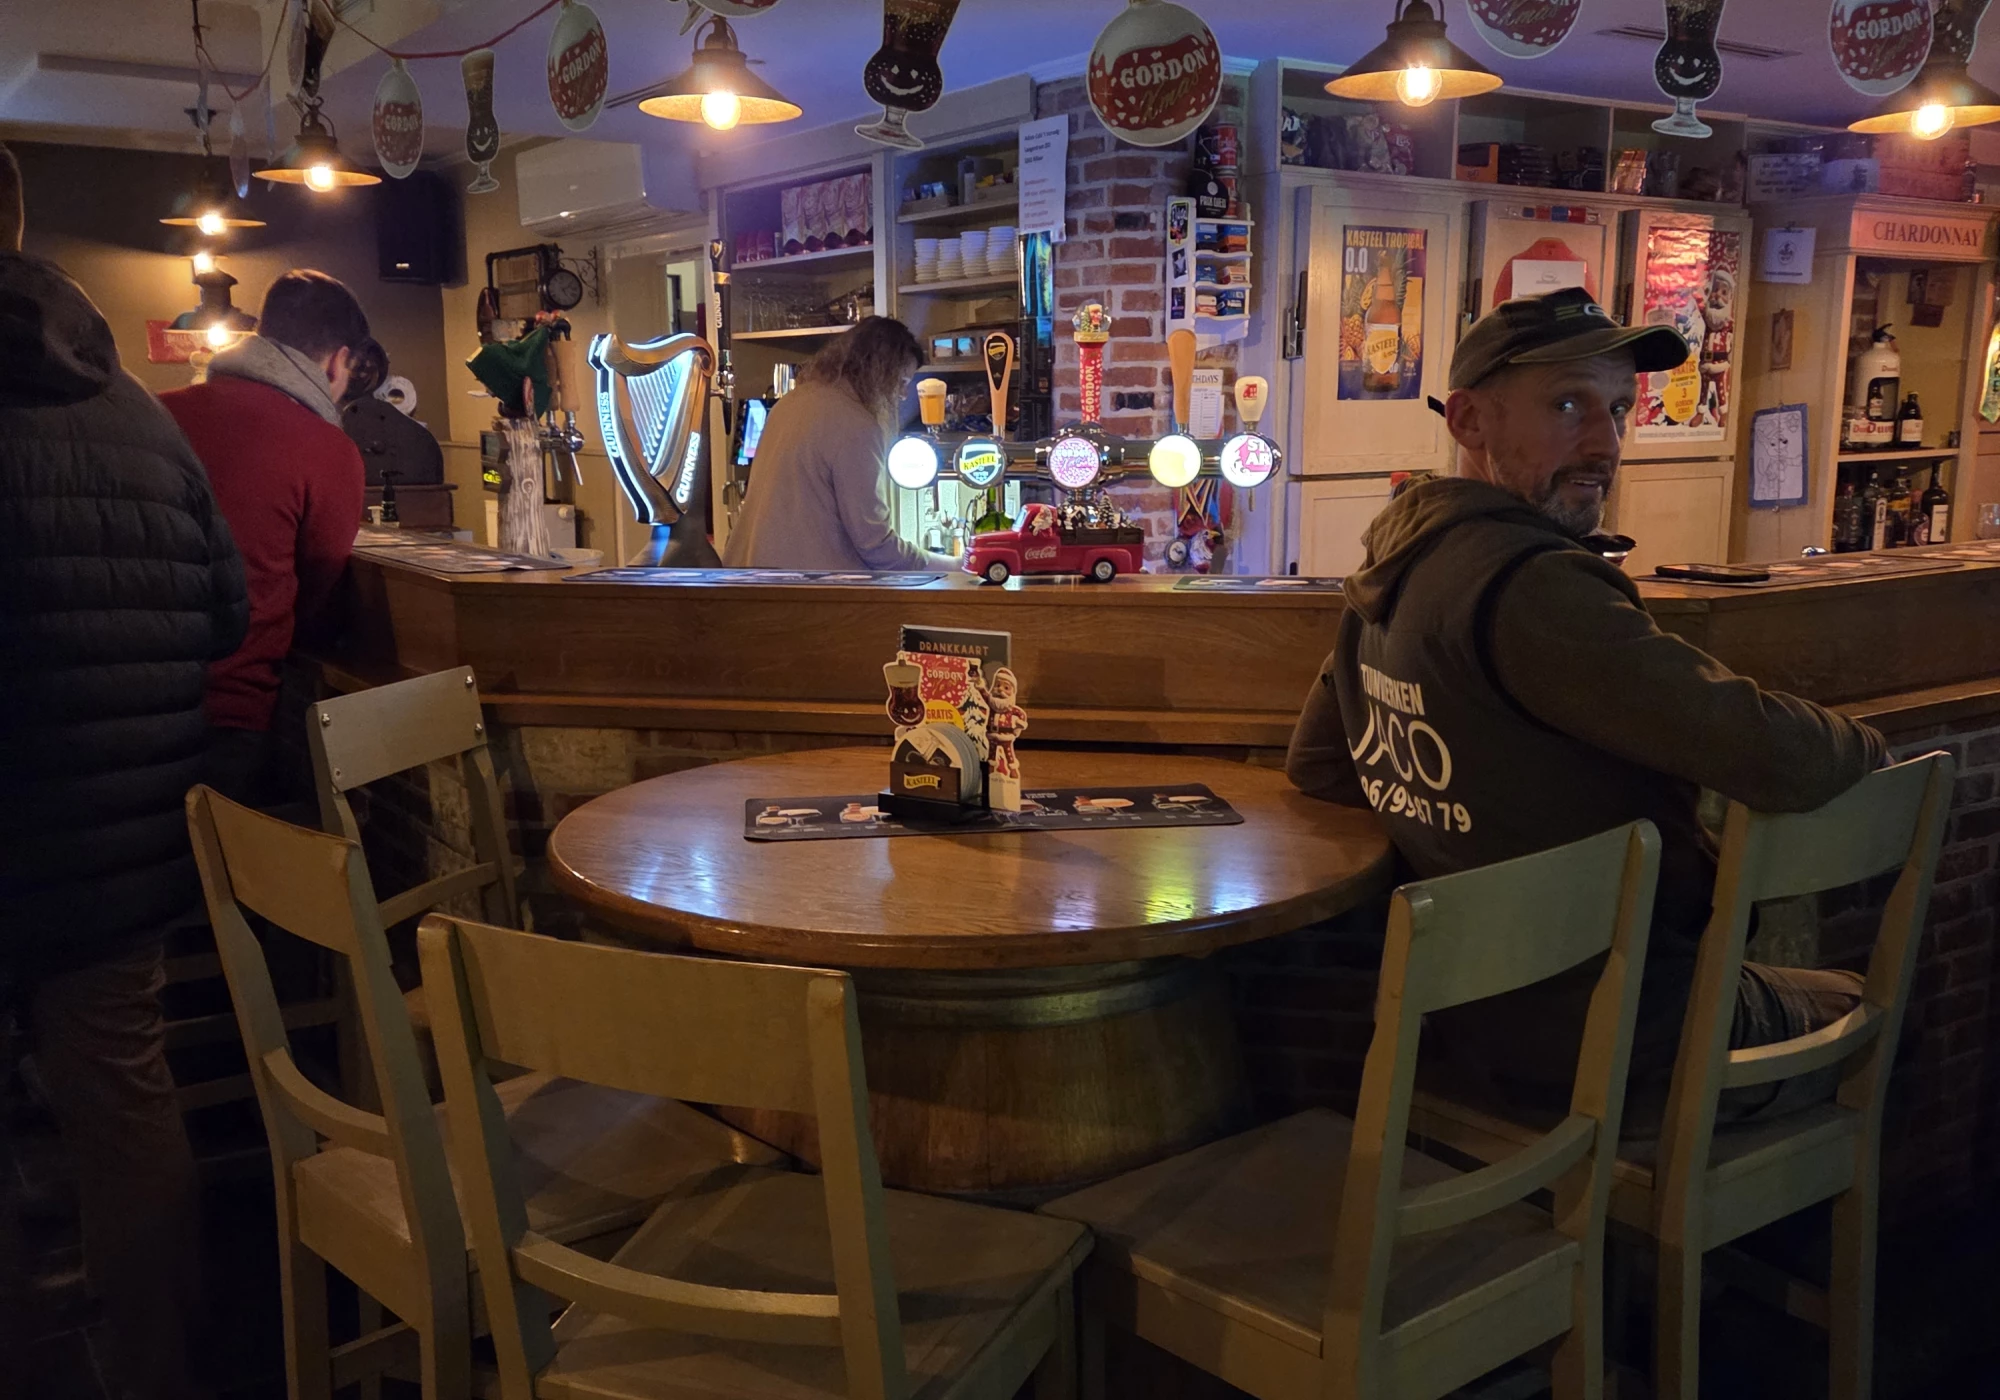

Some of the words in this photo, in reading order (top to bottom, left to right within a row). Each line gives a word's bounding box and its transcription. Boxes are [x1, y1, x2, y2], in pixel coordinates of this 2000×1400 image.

[1854, 7, 1923, 41] GORDON
[561, 40, 602, 84] GORDON
[1120, 46, 1209, 89] GORDON
[1346, 229, 1384, 248] KASTEEL
[1385, 231, 1425, 250] TROPICAL
[1872, 220, 1982, 247] CHARDONNAY
[1345, 246, 1368, 273] 0.0
[1085, 365, 1096, 413] GORDON
[599, 391, 621, 458] GUINNESS
[675, 431, 701, 504] GUINNESS
[962, 454, 998, 472] KASTEEL
[919, 641, 989, 657] DRANKKAART
[926, 668, 965, 682] GORDON
[926, 708, 954, 720] GRATIS
[1347, 699, 1453, 791] JACO
[905, 776, 937, 787] KASTEEL
[1436, 801, 1473, 834] 79
